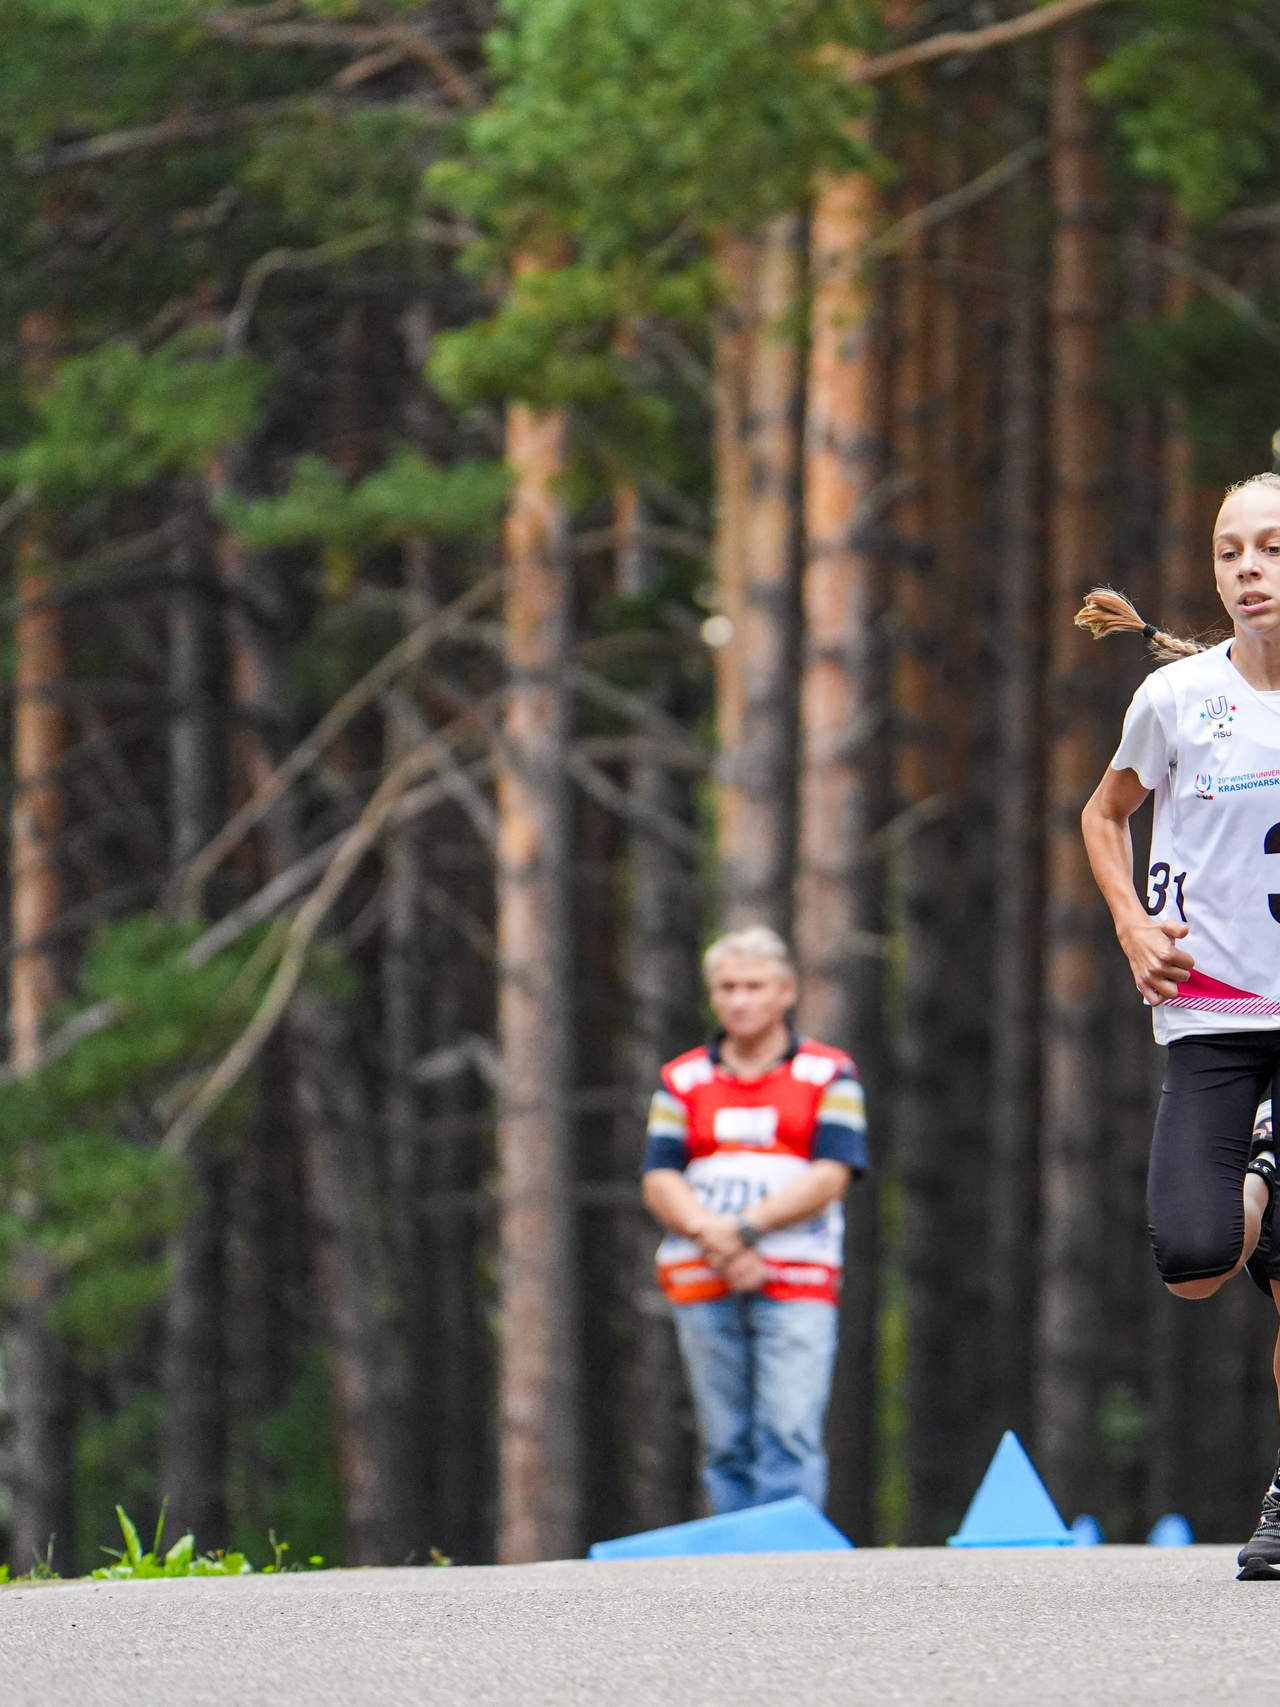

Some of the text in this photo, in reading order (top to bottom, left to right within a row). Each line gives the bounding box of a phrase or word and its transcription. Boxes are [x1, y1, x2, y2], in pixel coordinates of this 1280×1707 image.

[1213, 730, 1232, 738] FISU
[1230, 773, 1255, 782] WINTER
[1218, 778, 1280, 793] KRASNOYARSK
[1147, 862, 1187, 922] 31
